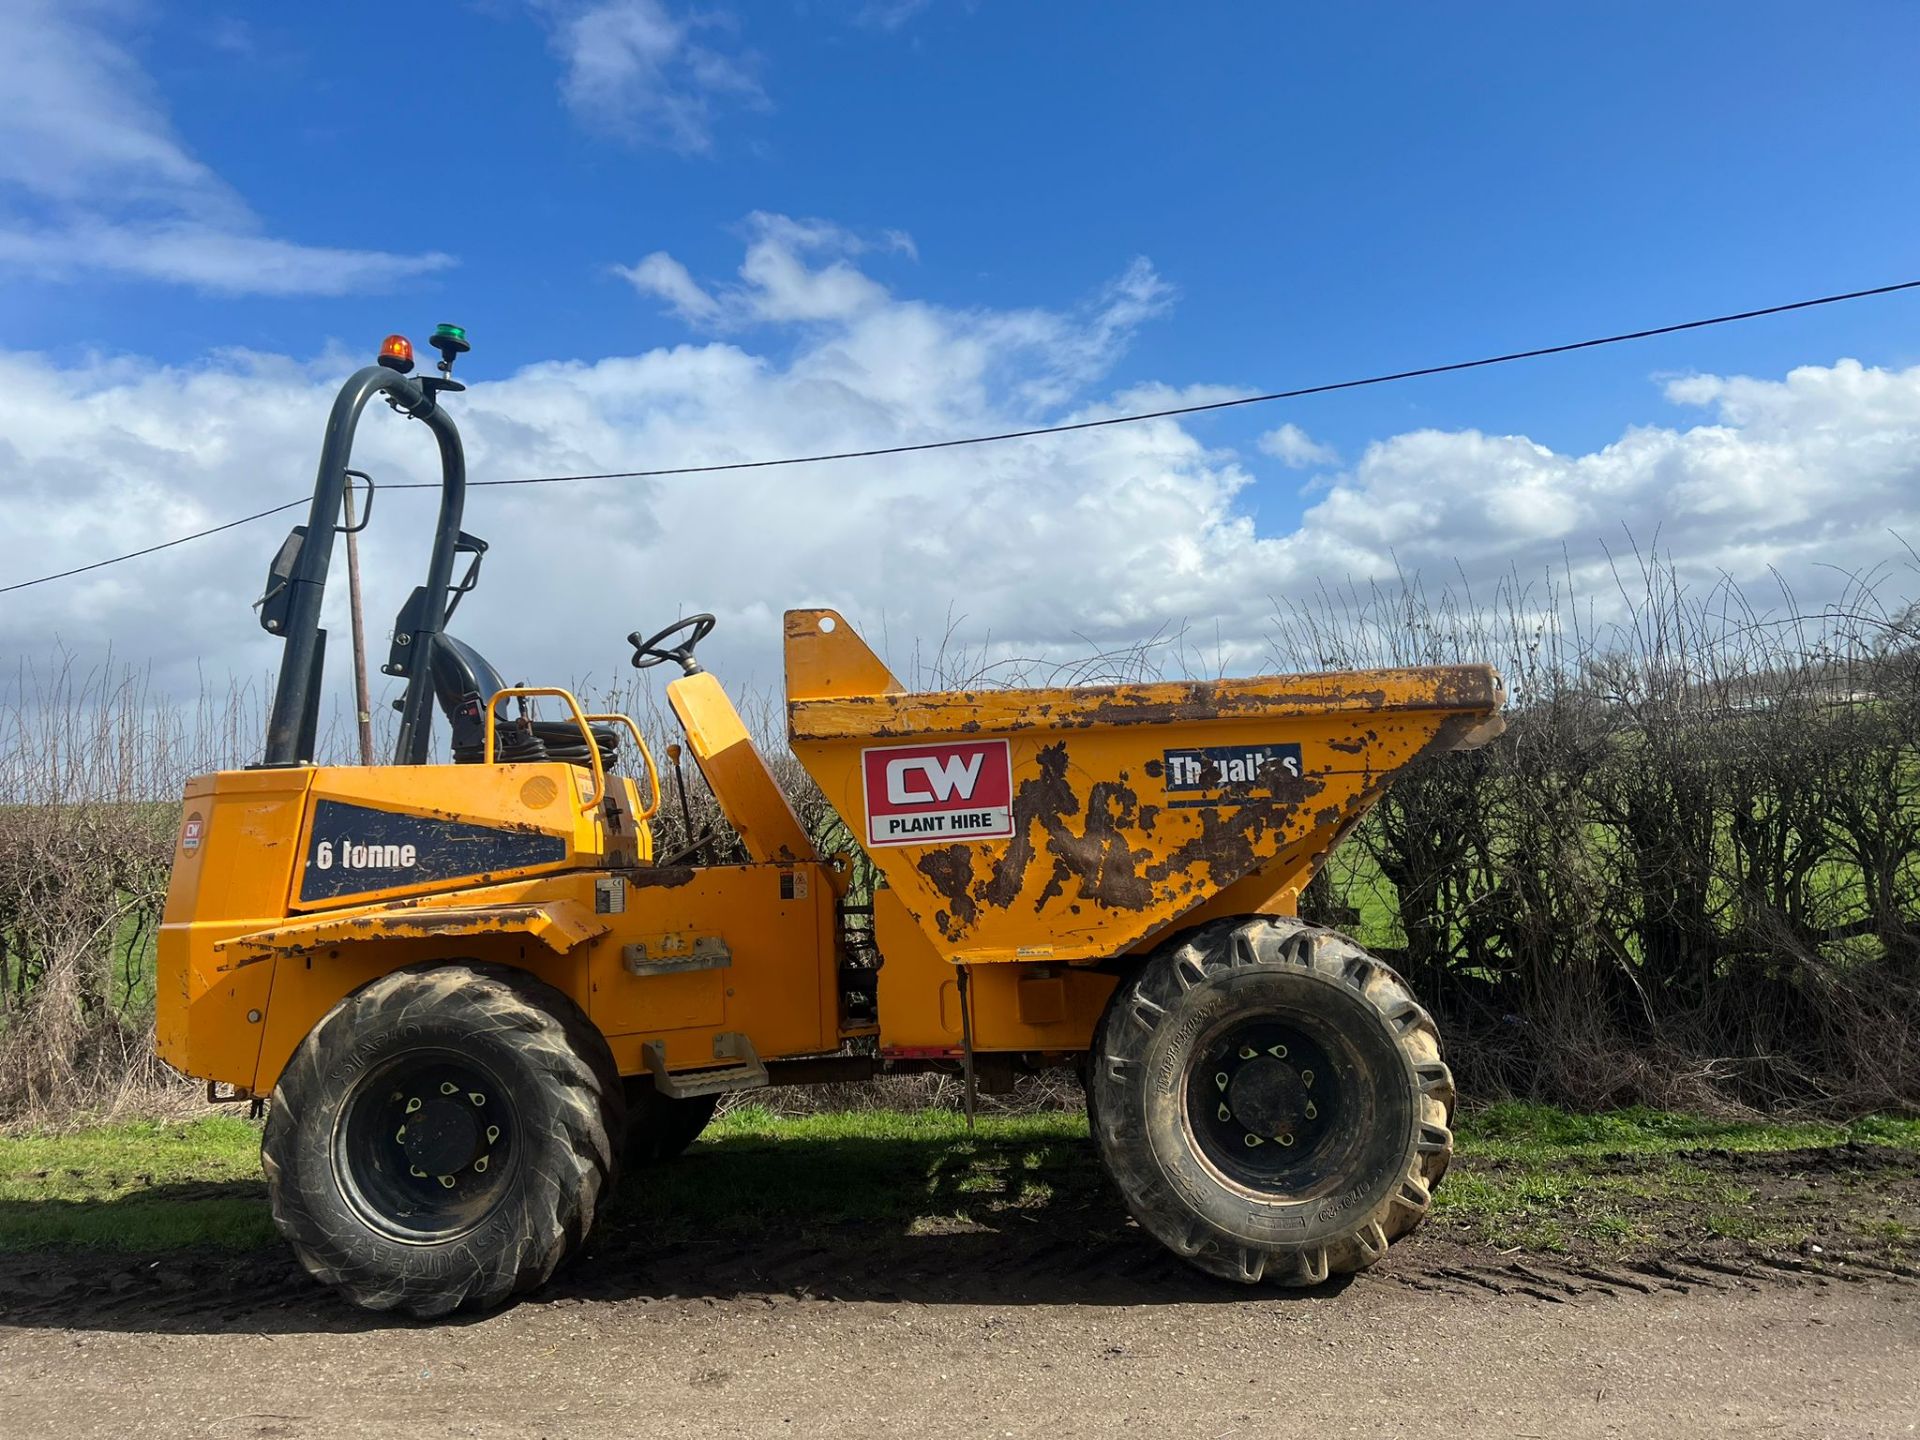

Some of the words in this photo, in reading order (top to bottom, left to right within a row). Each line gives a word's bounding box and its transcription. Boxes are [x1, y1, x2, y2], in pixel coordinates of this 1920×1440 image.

[886, 753, 984, 804] CW
[186, 823, 200, 837] CW
[889, 816, 945, 834] PLANT
[951, 813, 992, 829] HIRE
[317, 841, 333, 870] 6
[342, 840, 417, 869] tonne
